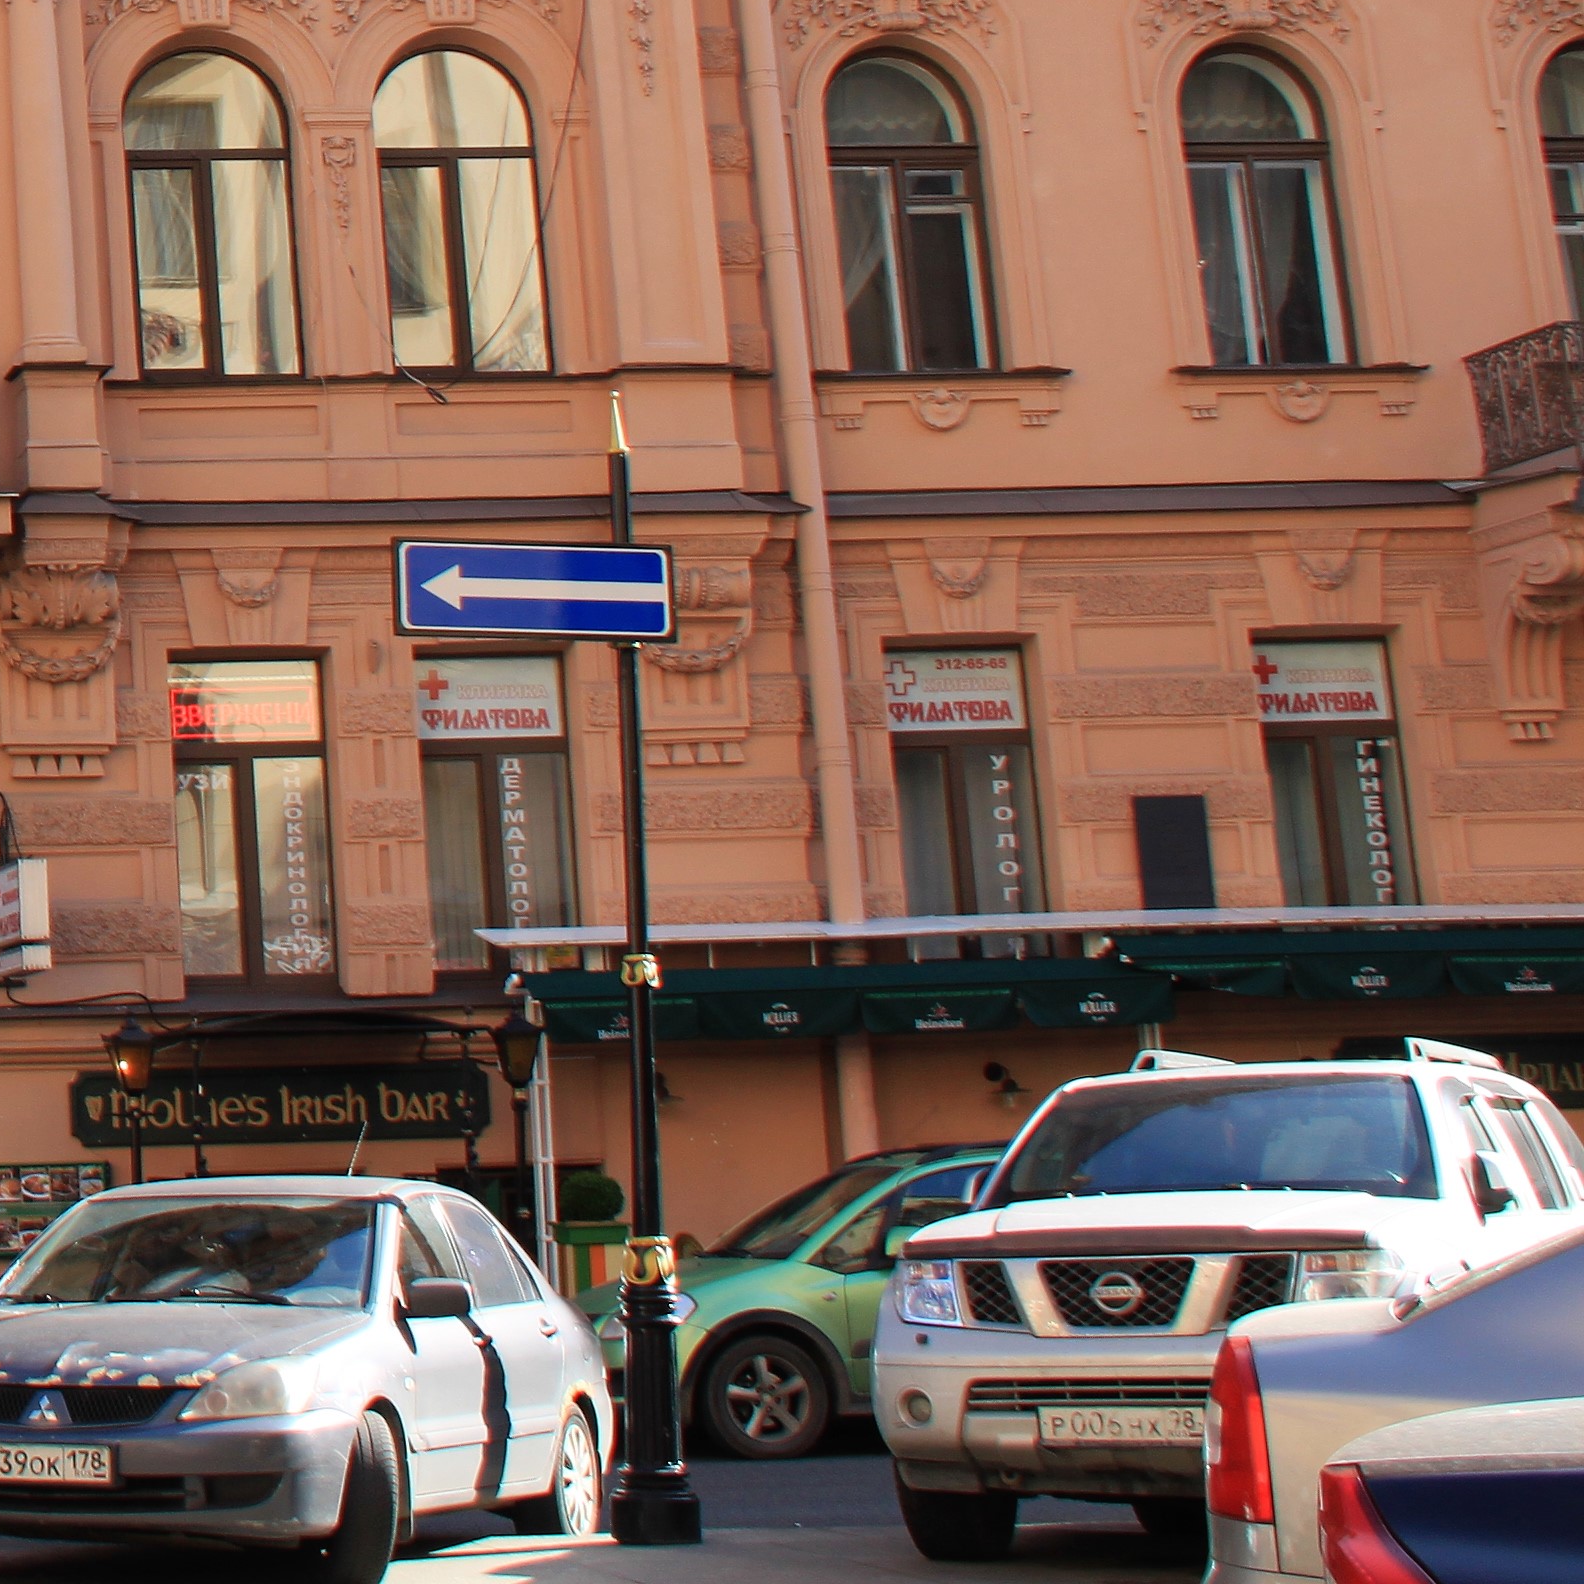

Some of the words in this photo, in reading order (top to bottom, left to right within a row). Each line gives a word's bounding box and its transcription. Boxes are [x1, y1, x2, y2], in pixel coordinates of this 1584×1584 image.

[935, 658, 1007, 670] 312-65-65
[457, 683, 550, 700] КЛИНИКА
[1257, 691, 1379, 714] ФИЛАТОВА
[421, 708, 552, 730] ФИЛАТОВА
[888, 700, 1013, 722] ФИЛАТОВА
[177, 770, 229, 790] УЗИ
[989, 754, 1021, 902] УРОЛОГ
[1355, 740, 1395, 903] ГИНЕКОЛОГ
[501, 757, 530, 929] ДЕРМАТОЛОГ
[67, 1449, 100, 1470] 178
